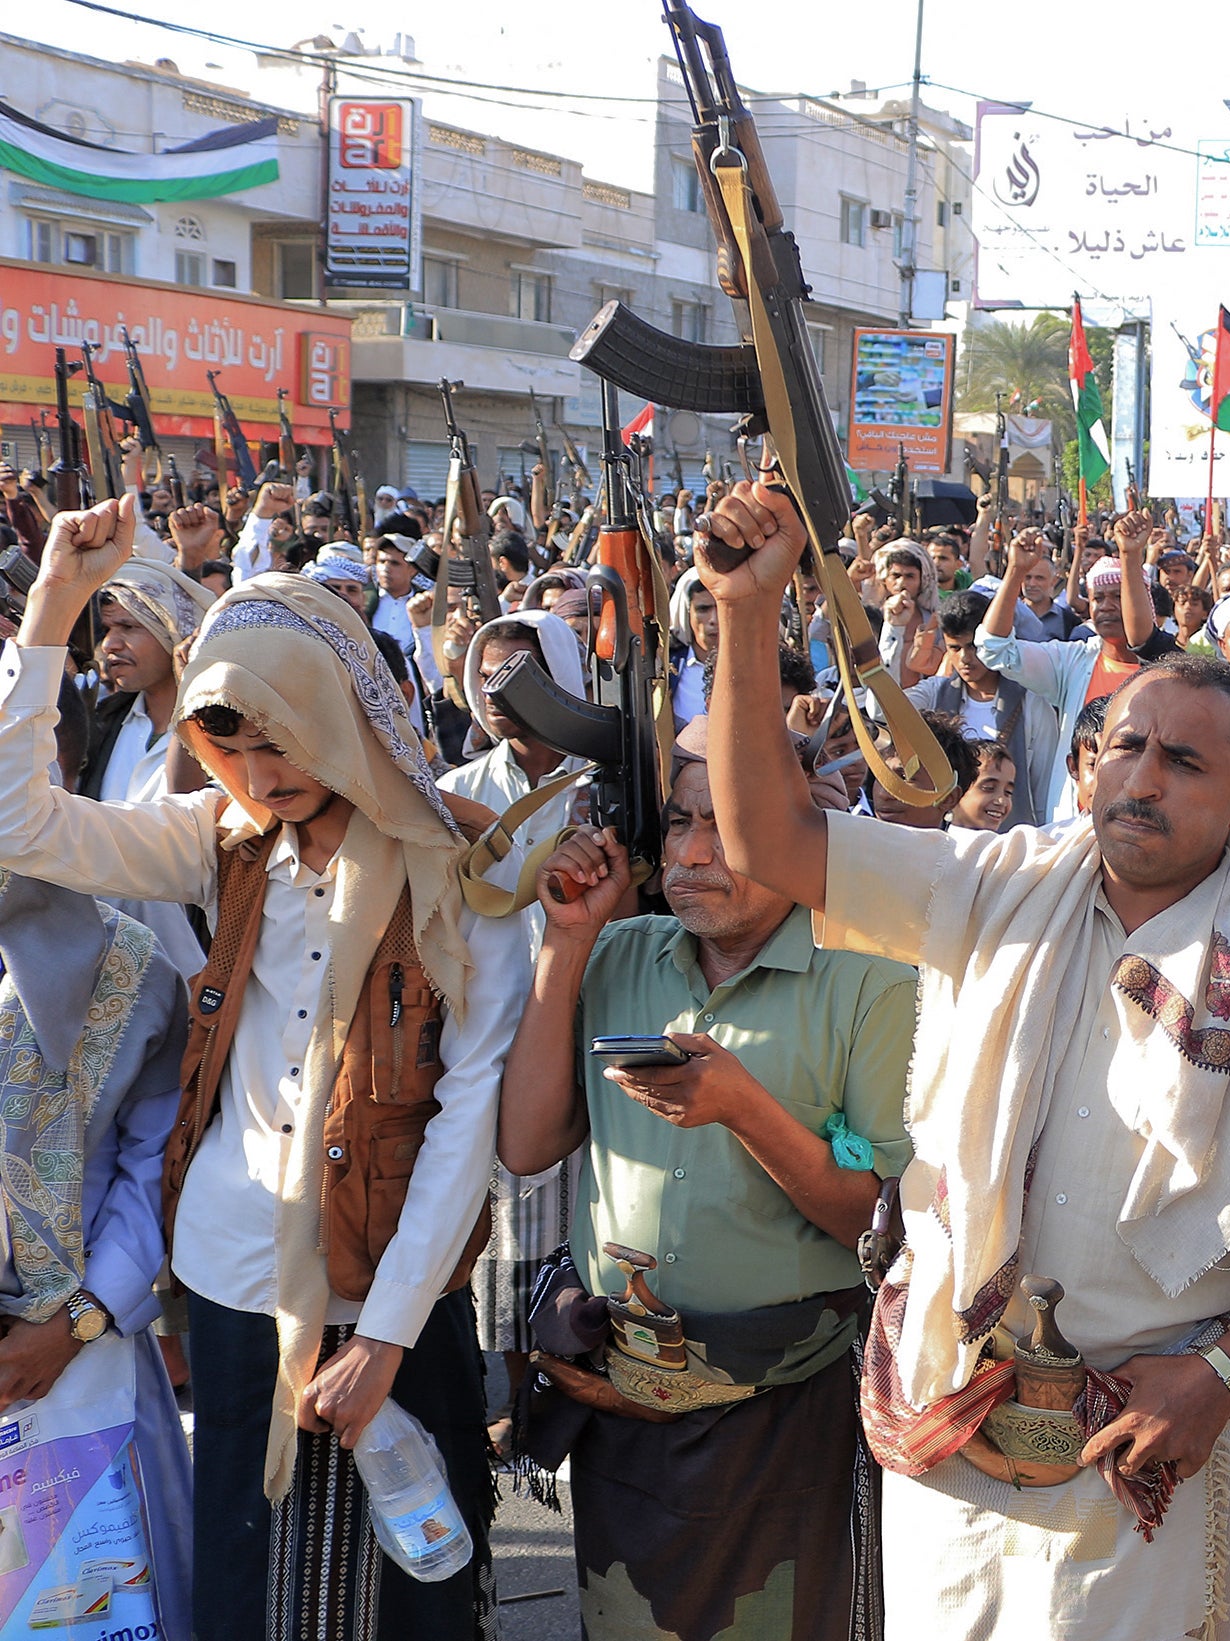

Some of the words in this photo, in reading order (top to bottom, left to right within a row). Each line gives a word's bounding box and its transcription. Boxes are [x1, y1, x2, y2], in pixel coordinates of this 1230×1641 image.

[1137, 119, 1172, 146] من
[1086, 174, 1158, 204] الحياة
[1130, 230, 1186, 260] عاش
[27, 298, 178, 371] والمفروشات
[184, 316, 244, 366] للأثاث
[30, 1467, 81, 1495] فيكسيم
